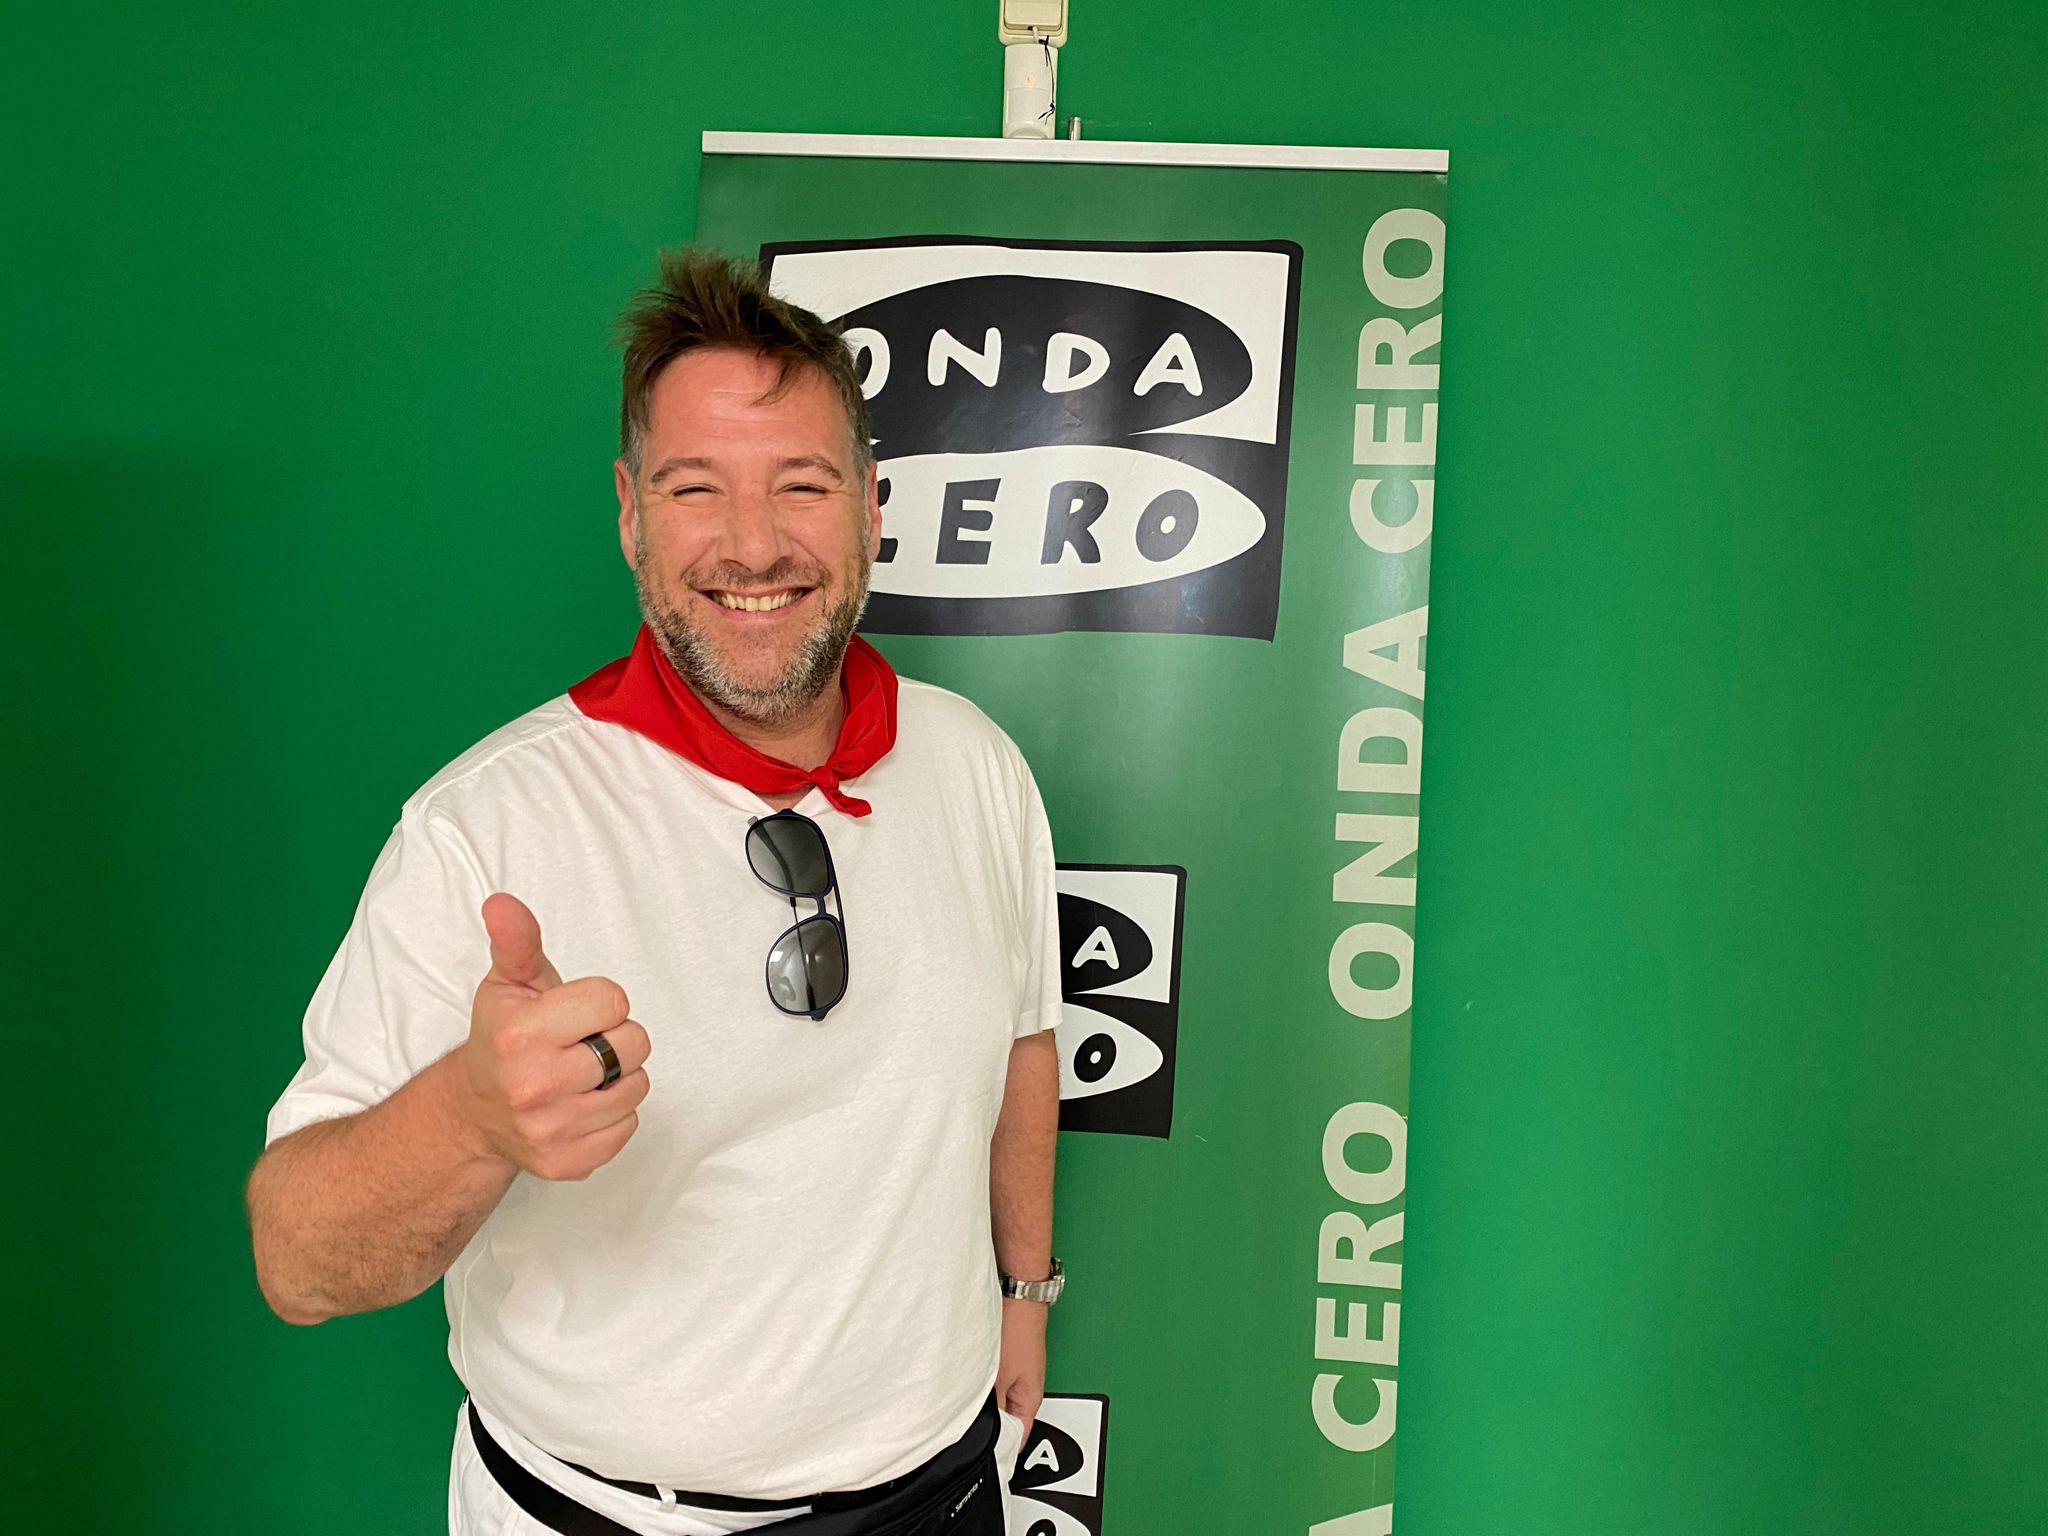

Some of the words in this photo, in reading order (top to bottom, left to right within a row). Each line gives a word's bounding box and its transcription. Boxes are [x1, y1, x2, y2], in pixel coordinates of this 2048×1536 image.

[841, 327, 1204, 400] ONDA
[1349, 208, 1446, 554] CERO
[1329, 604, 1429, 1020] ONDA
[1311, 1101, 1408, 1452] CERO
